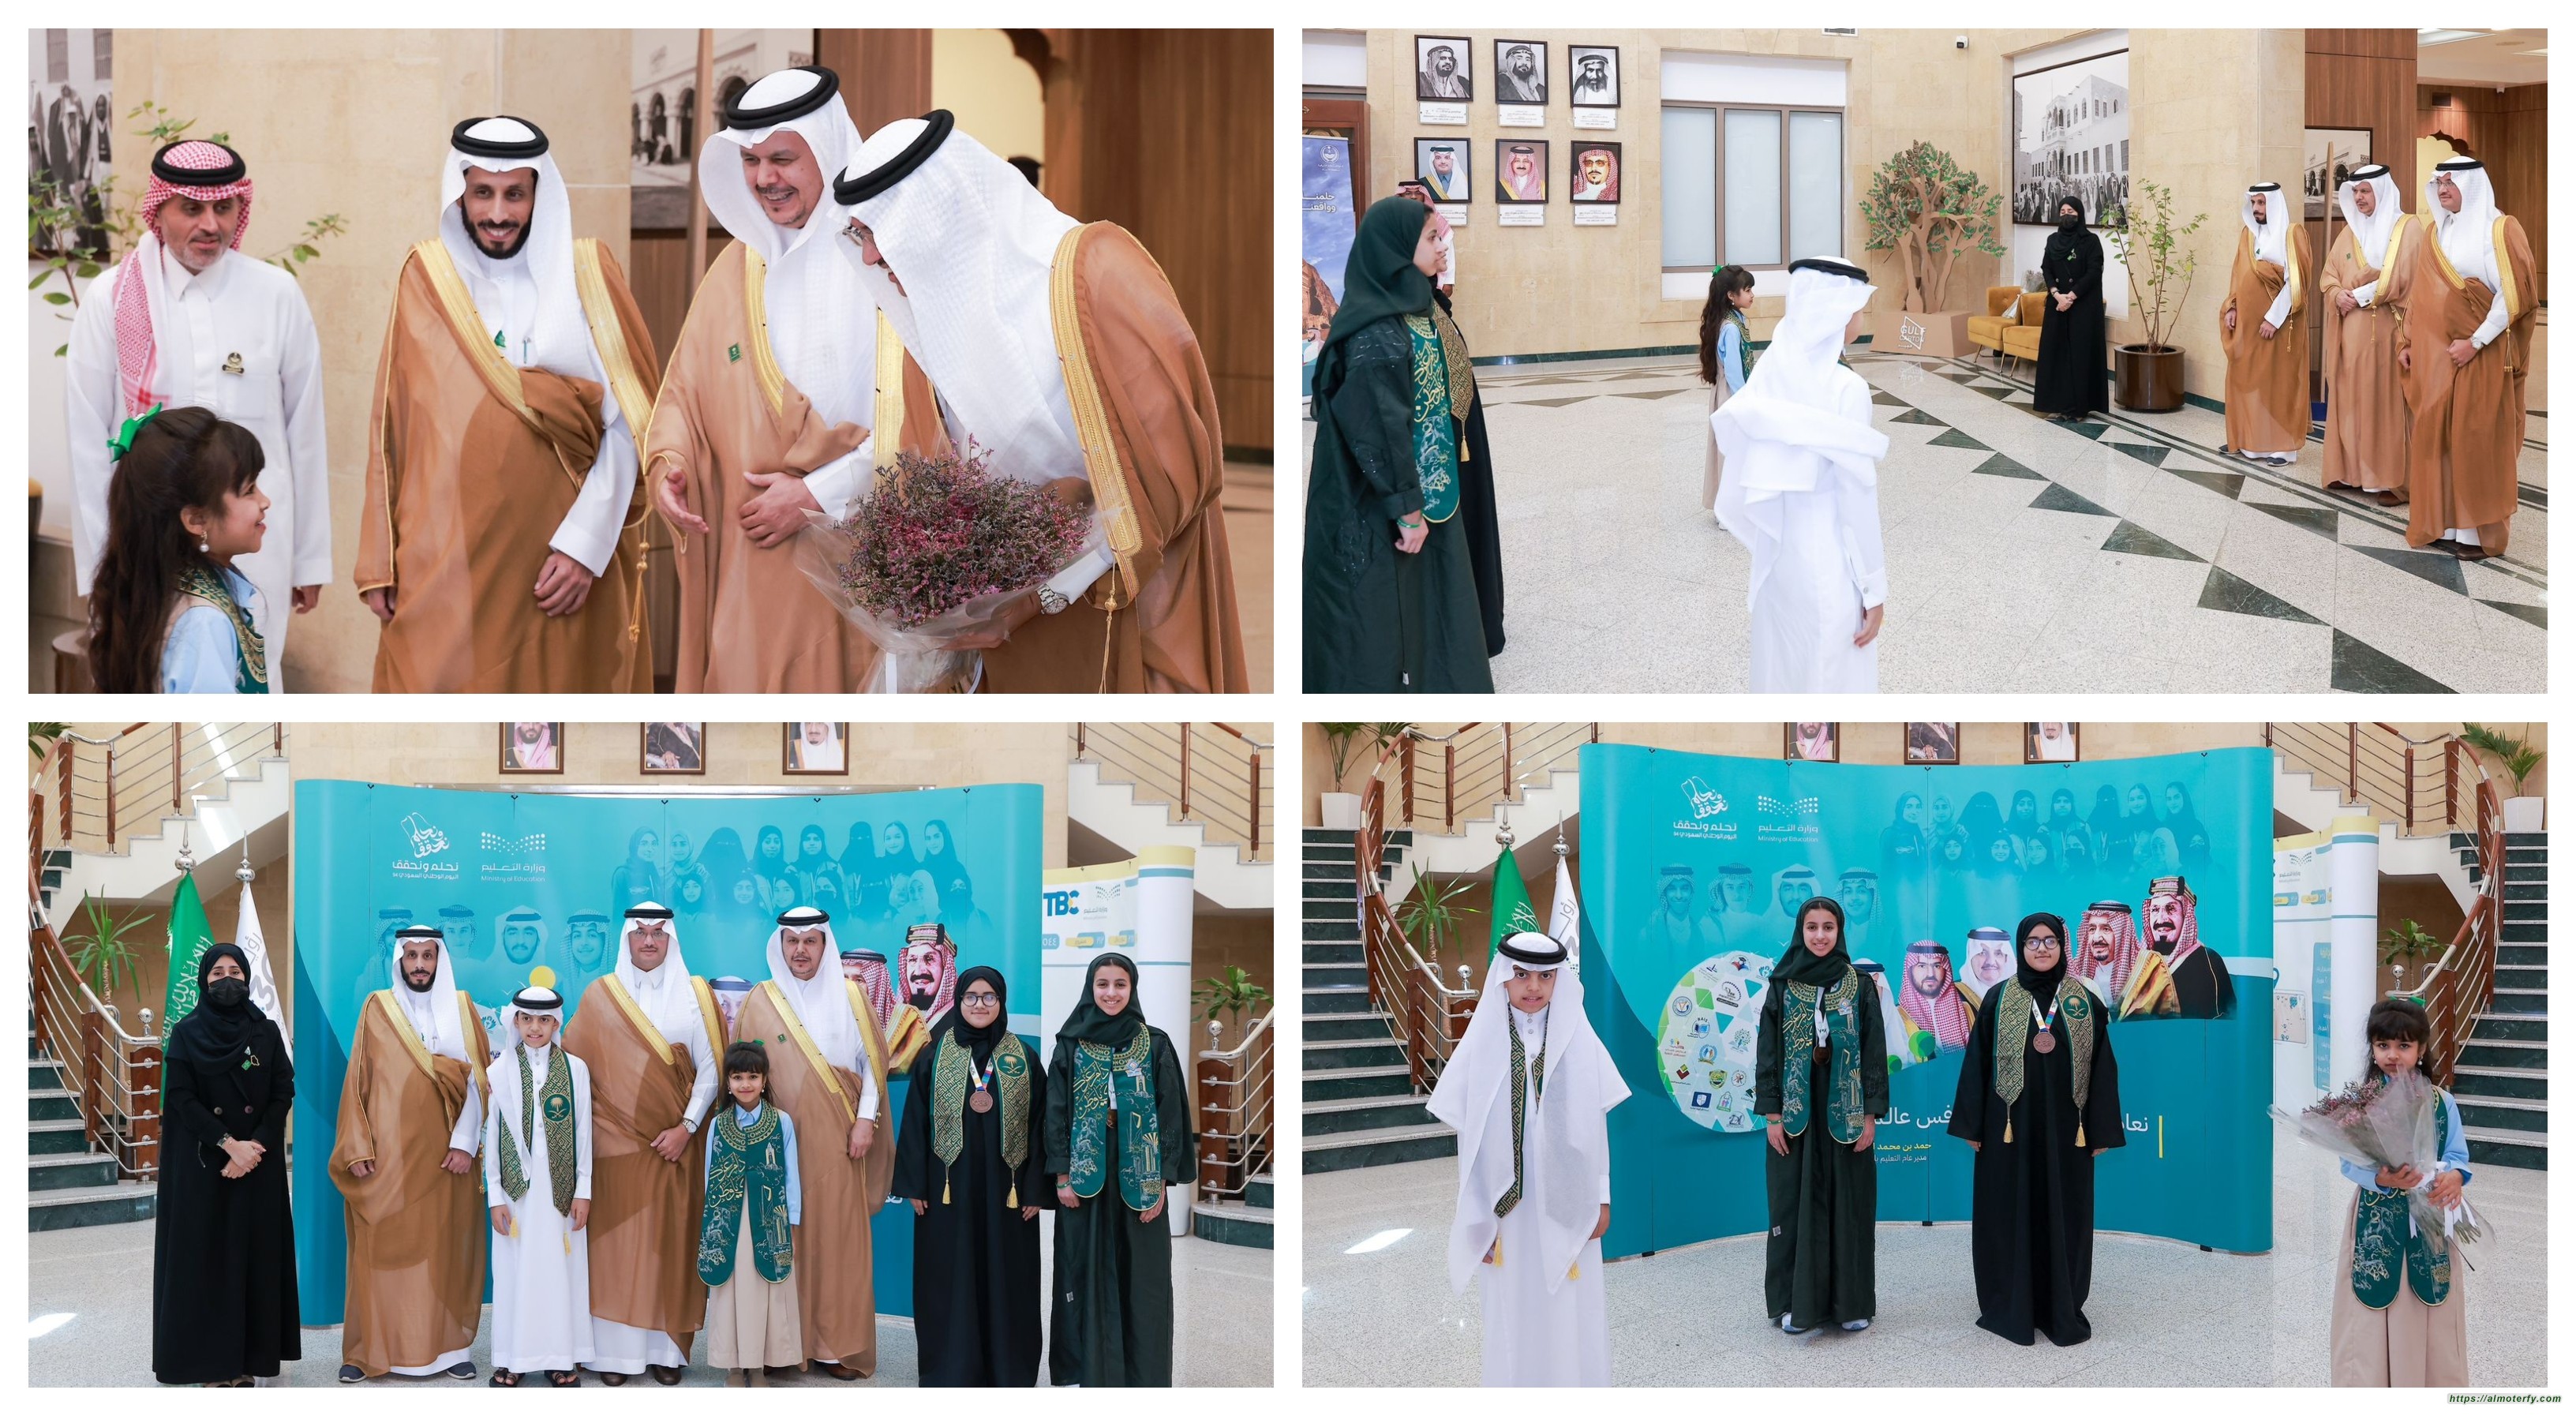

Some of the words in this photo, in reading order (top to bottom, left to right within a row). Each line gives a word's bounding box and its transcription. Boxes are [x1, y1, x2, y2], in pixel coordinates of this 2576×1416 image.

[1302, 202, 1336, 213] وواقعن
[1900, 326, 1926, 335] GULF
[1673, 820, 1709, 833] ونحقق
[1710, 822, 1737, 831] نحلم
[1758, 824, 1795, 833] التعليم
[1797, 824, 1818, 833] وزارة
[392, 860, 429, 872] ونحقق
[431, 862, 459, 871] نحلم
[481, 863, 521, 873] التعليم
[523, 863, 545, 873] وزارة
[1916, 1105, 1953, 1129] فس
[1880, 1154, 1901, 1164] التعليم
[1901, 1155, 1913, 1164] عام
